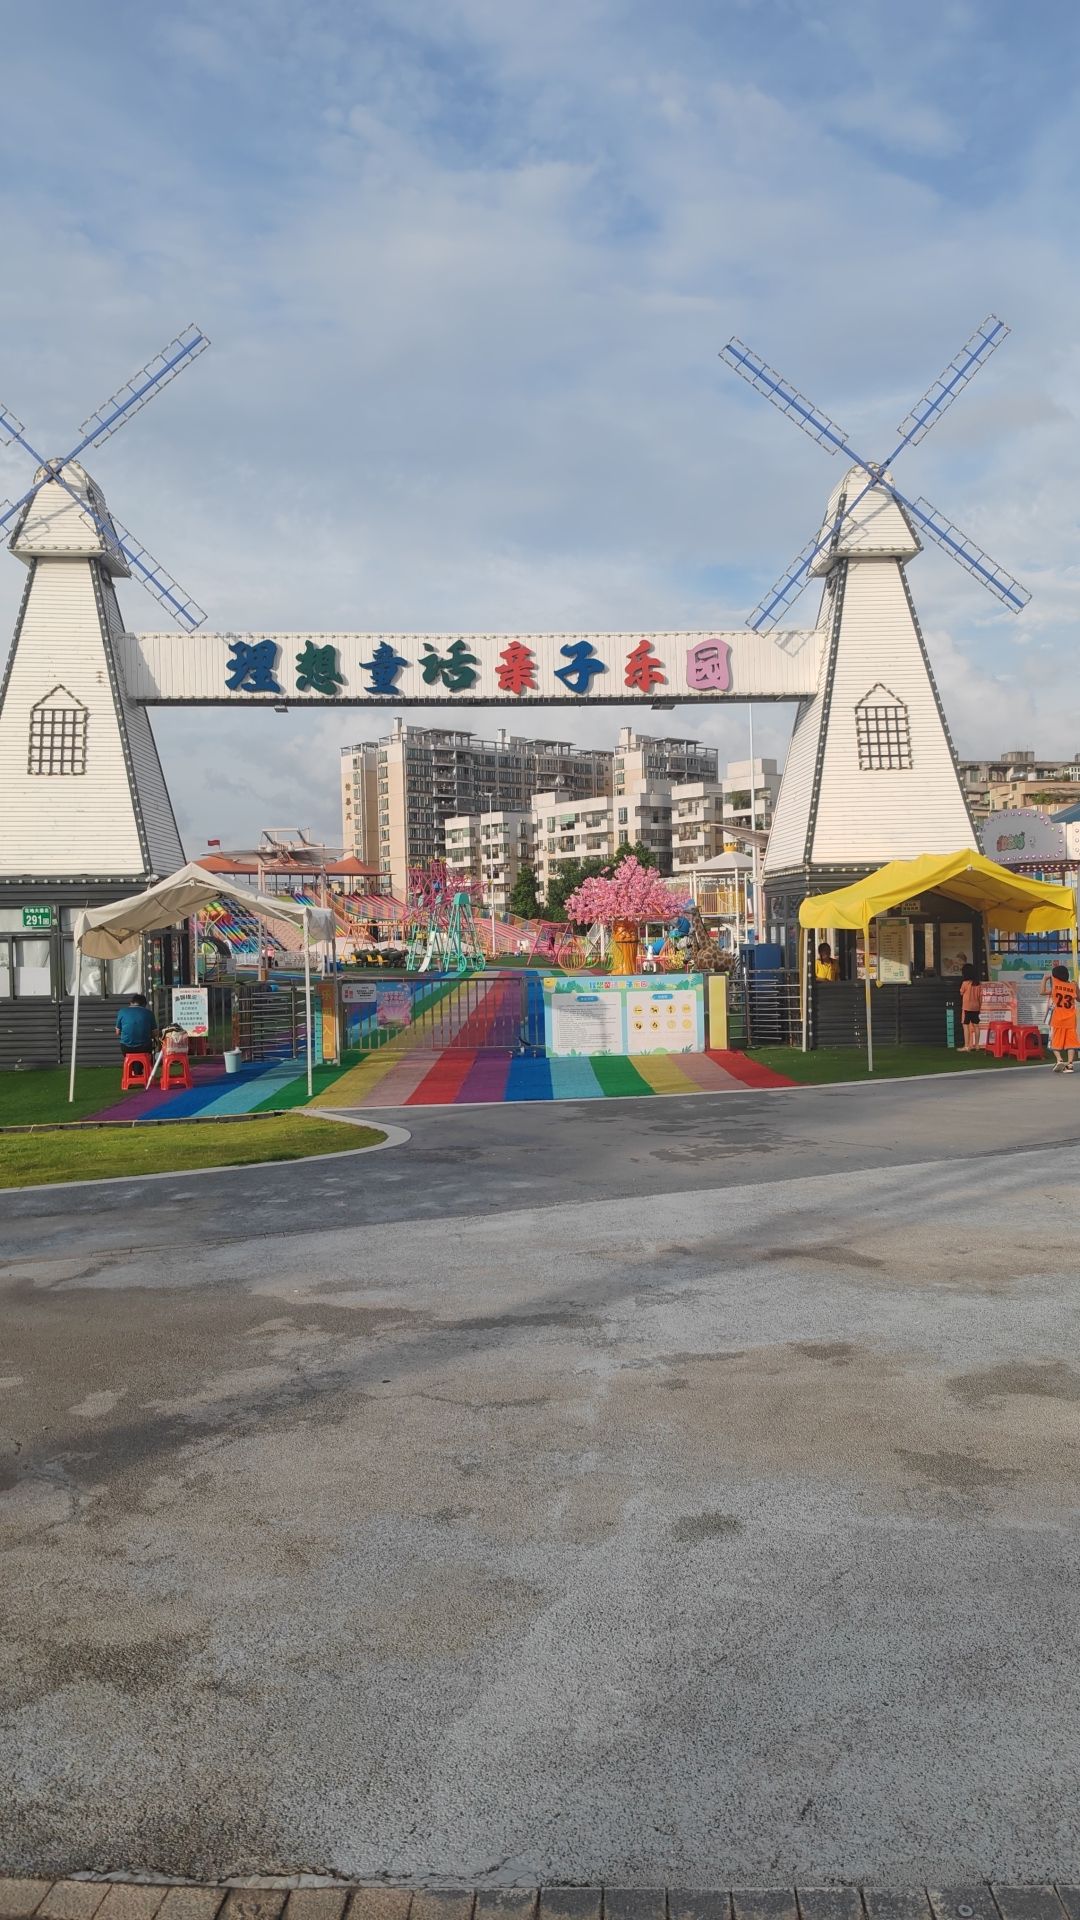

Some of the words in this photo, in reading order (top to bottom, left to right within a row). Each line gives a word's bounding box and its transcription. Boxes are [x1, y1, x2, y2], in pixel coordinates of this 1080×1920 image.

[225, 638, 732, 695] 理想童话亲子乐园
[1056, 993, 1073, 1009] 23
